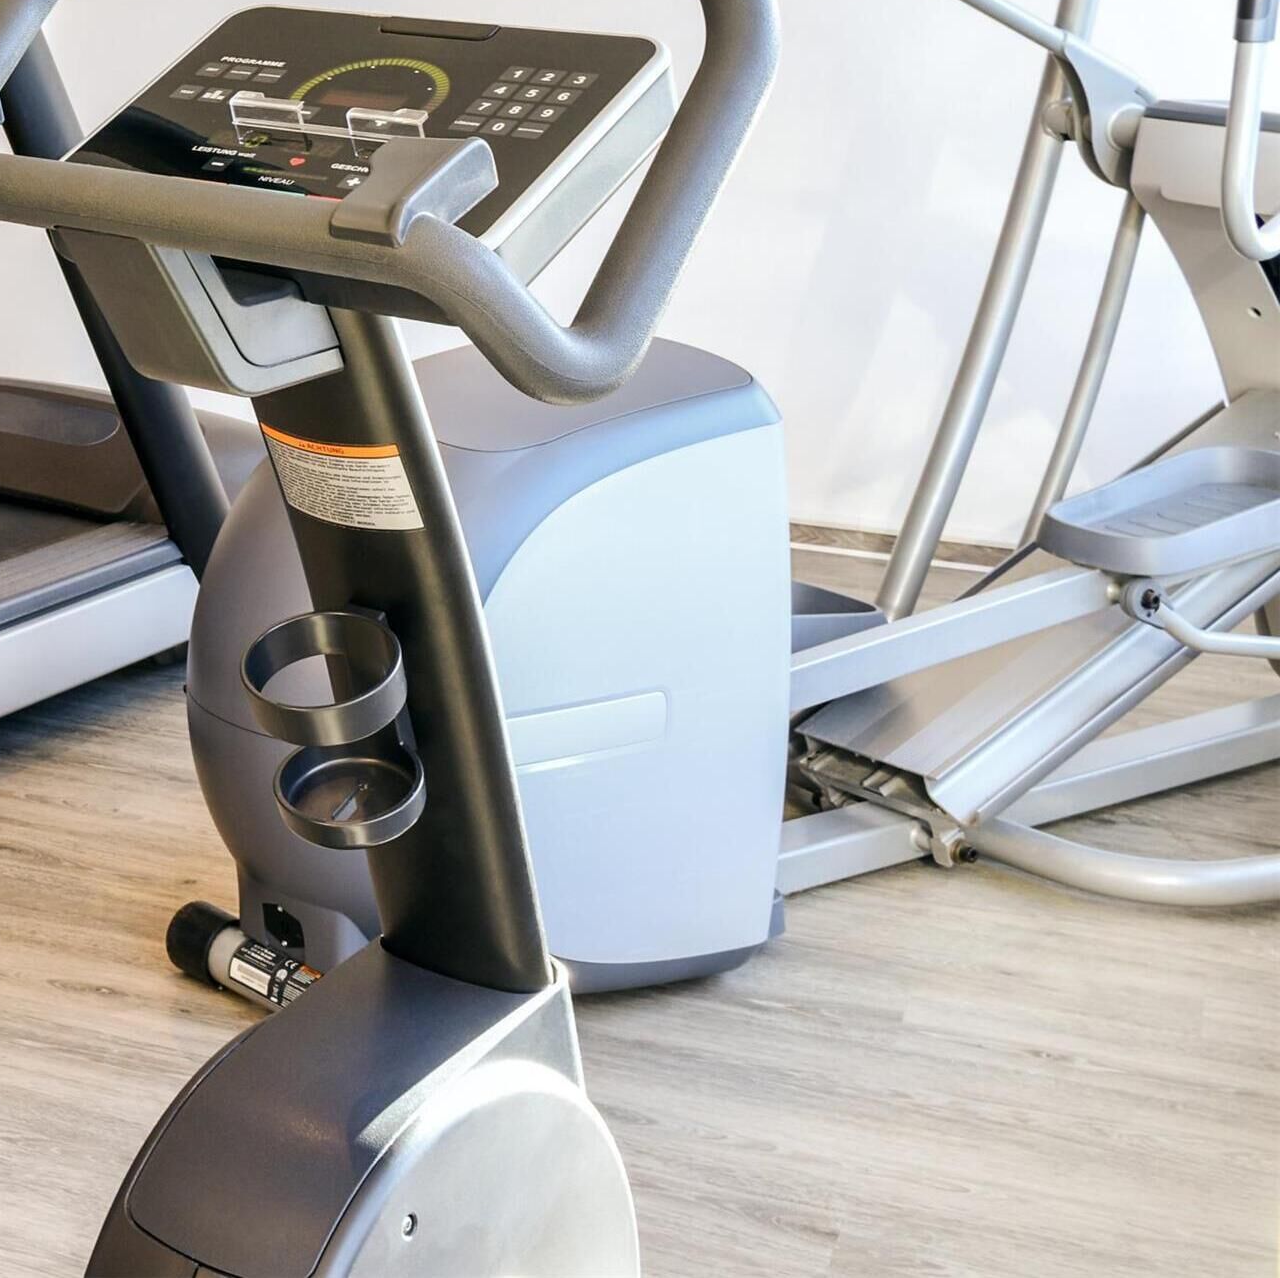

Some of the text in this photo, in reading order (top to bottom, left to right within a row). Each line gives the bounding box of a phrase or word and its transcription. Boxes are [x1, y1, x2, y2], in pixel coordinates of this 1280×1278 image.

[220, 56, 287, 68] PROGRAMME
[513, 70, 587, 84] 1 2 3
[493, 86, 571, 101] 4 5 6
[477, 102, 554, 117] 7 8 9
[491, 122, 505, 131] 0
[191, 145, 238, 156] LEISTUNG
[258, 175, 296, 186] NIVEAU
